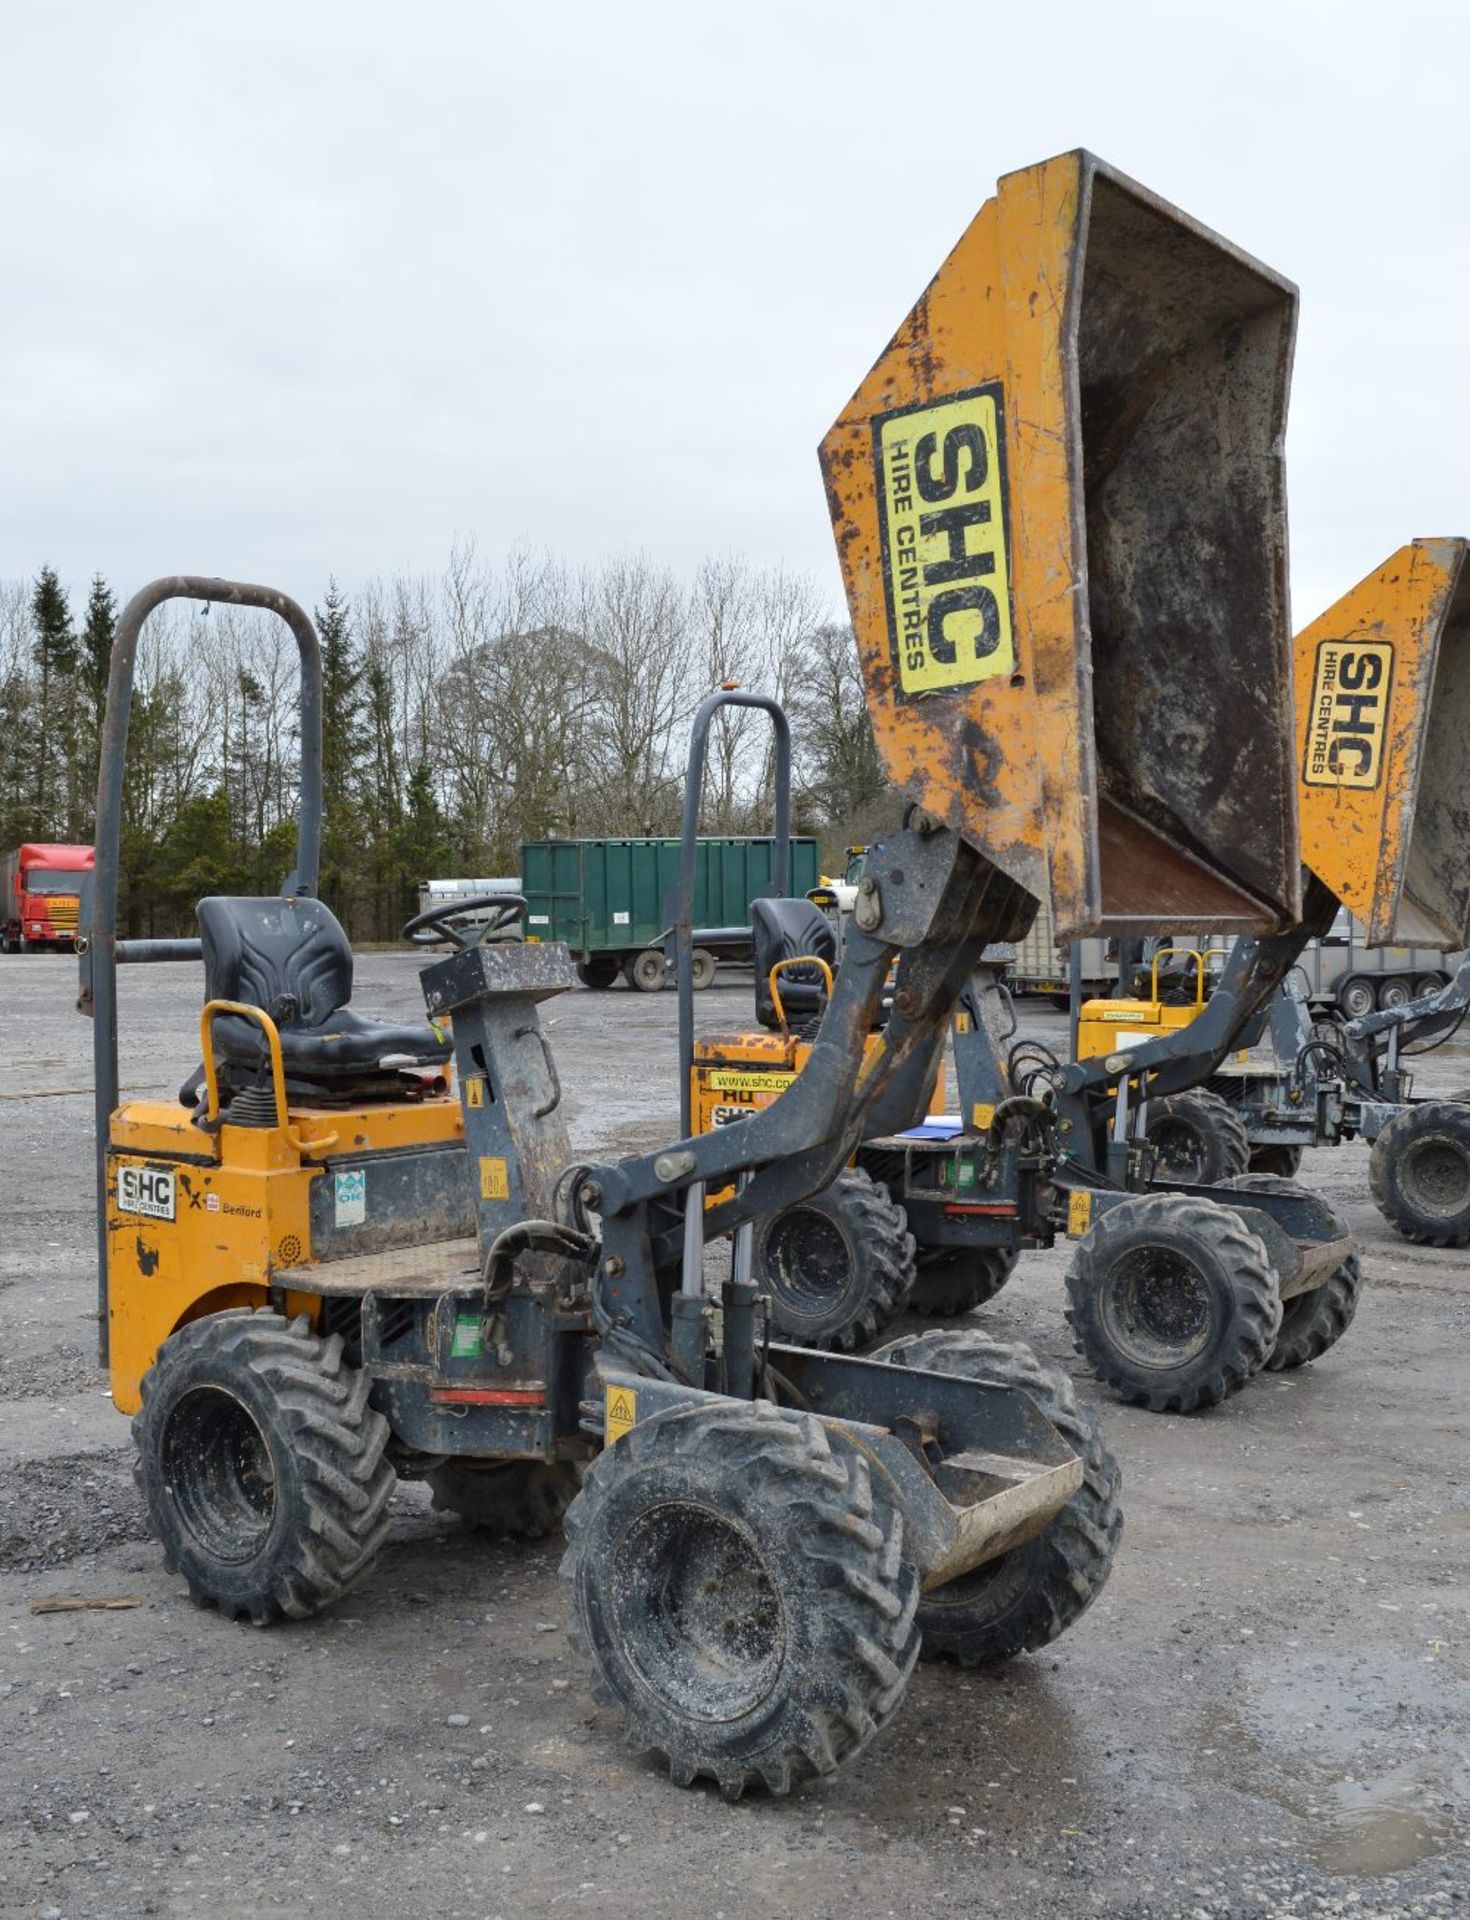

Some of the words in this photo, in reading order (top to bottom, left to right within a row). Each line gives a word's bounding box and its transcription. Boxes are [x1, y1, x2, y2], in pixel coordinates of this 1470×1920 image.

[888, 439, 913, 515] HIRE
[914, 423, 1001, 665] SHC
[896, 525, 925, 671] CENTRES
[1322, 651, 1338, 691] HIRE
[1312, 695, 1333, 774] CENTRES
[1328, 652, 1382, 777] SHC
[715, 1107, 757, 1125] SH
[123, 1170, 170, 1205] SHC
